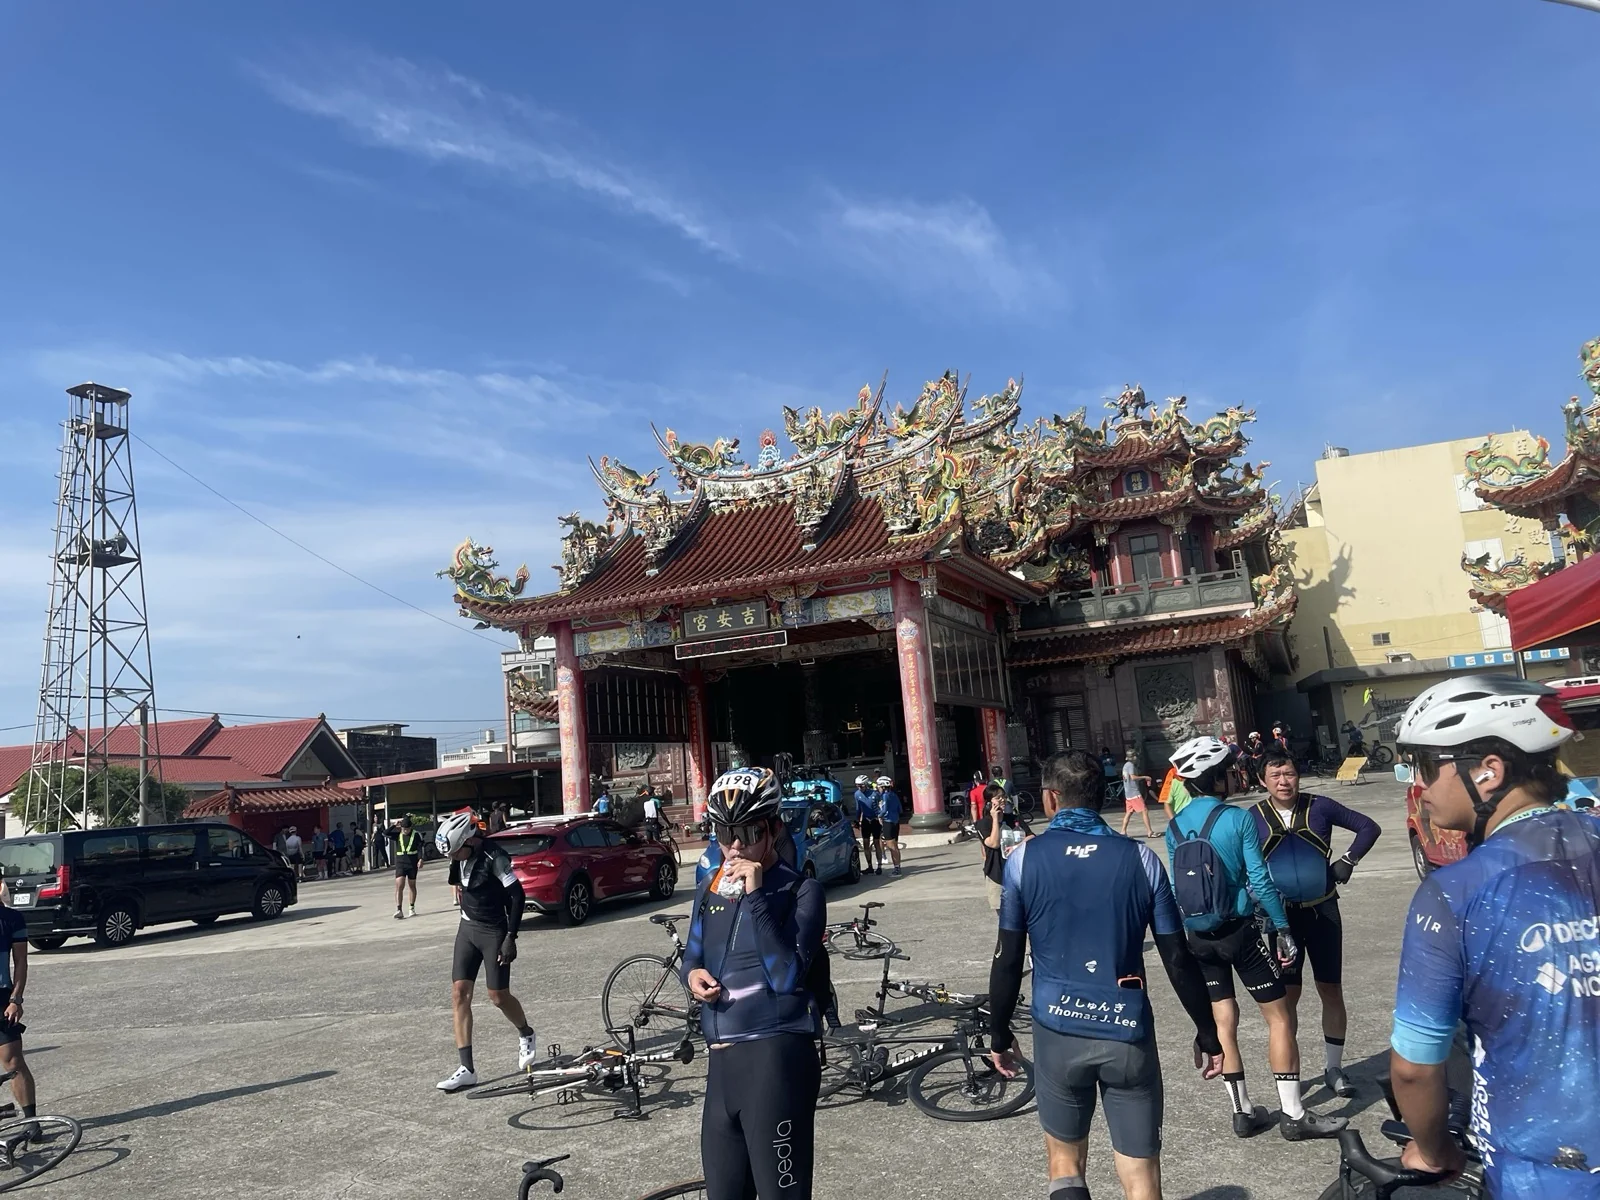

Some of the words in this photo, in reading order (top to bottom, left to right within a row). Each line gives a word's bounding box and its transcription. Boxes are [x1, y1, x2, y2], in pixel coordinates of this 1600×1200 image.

[692, 606, 756, 632] 吉安宮
[1408, 692, 1436, 727] MET
[1490, 697, 1530, 710] MET
[1065, 844, 1098, 859] HLP
[1048, 1004, 1098, 1021] Thomas
[1114, 1015, 1138, 1028] Lee
[772, 1119, 798, 1189] pedla
